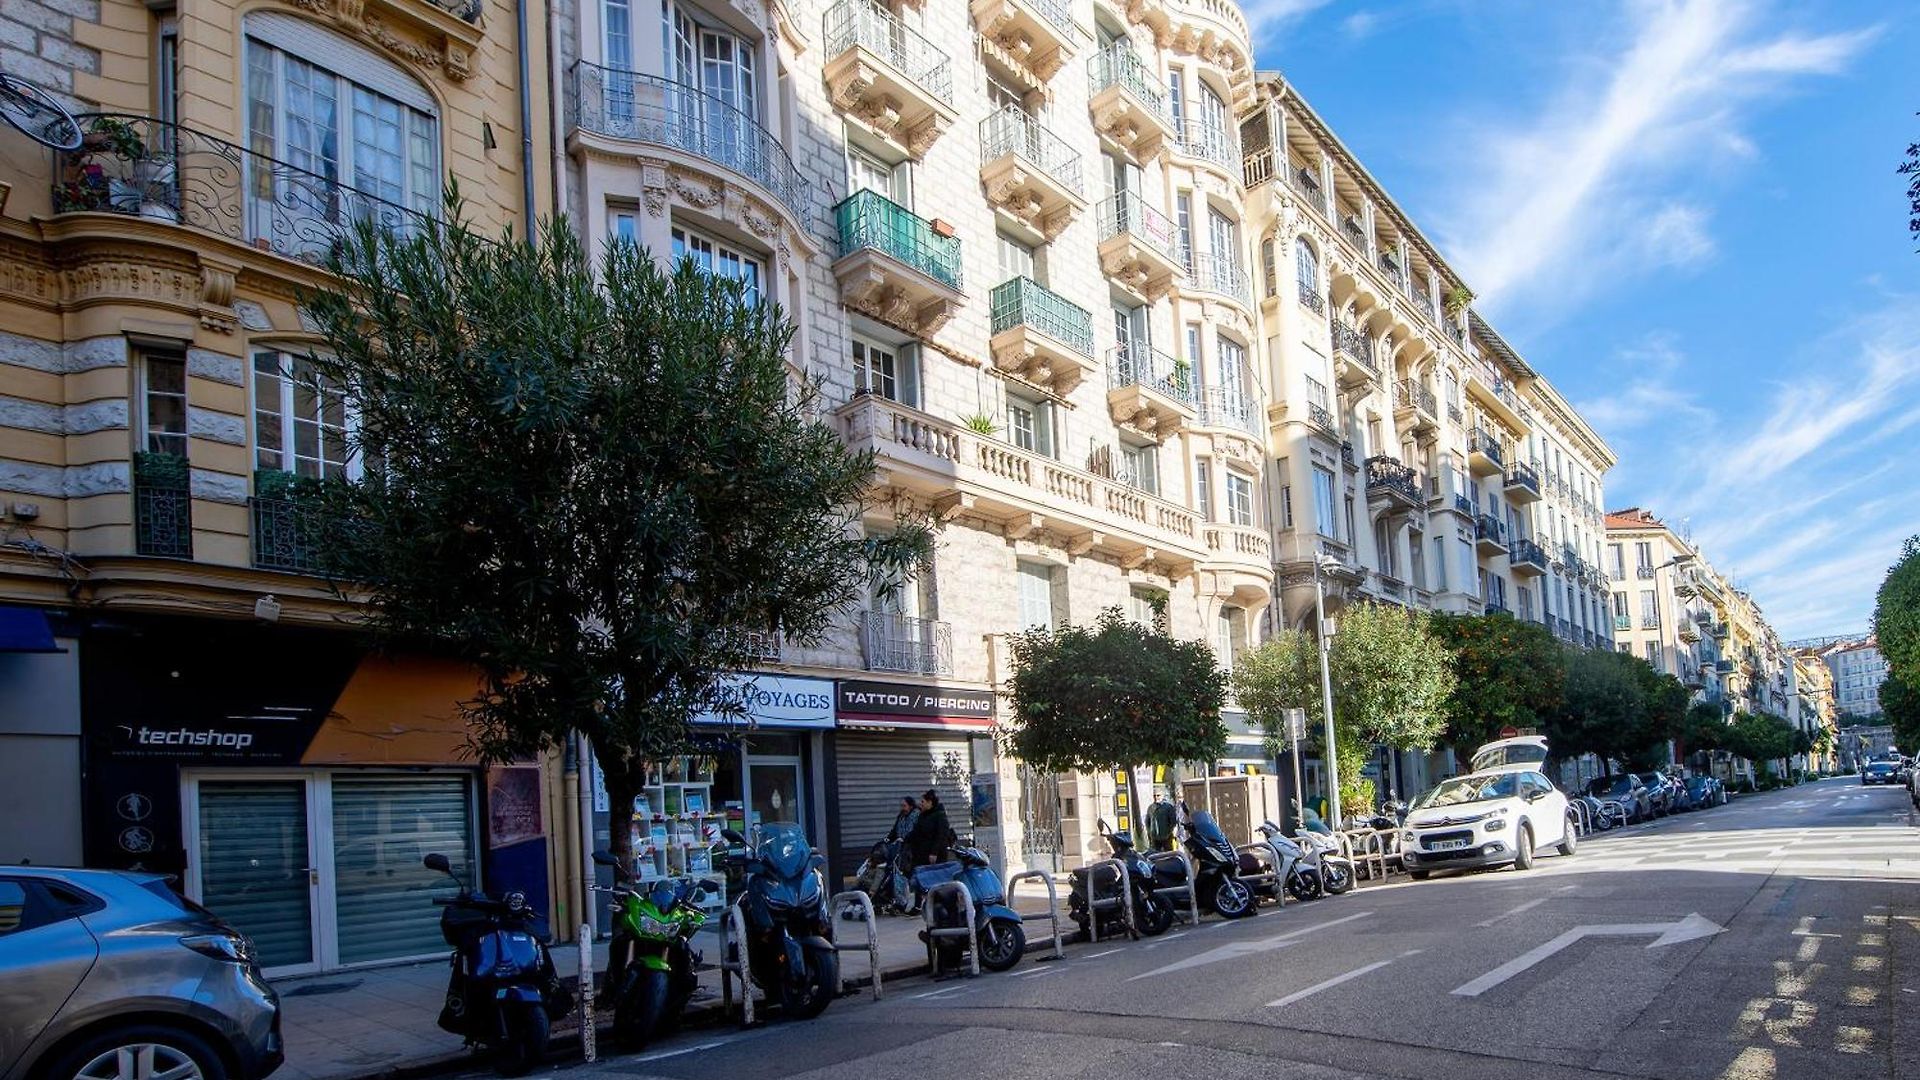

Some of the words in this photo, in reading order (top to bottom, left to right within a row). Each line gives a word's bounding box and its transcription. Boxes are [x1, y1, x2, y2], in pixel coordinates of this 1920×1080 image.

[846, 692, 909, 705] TATTOO
[925, 697, 990, 711] PIERCING
[138, 726, 253, 749] techshop
